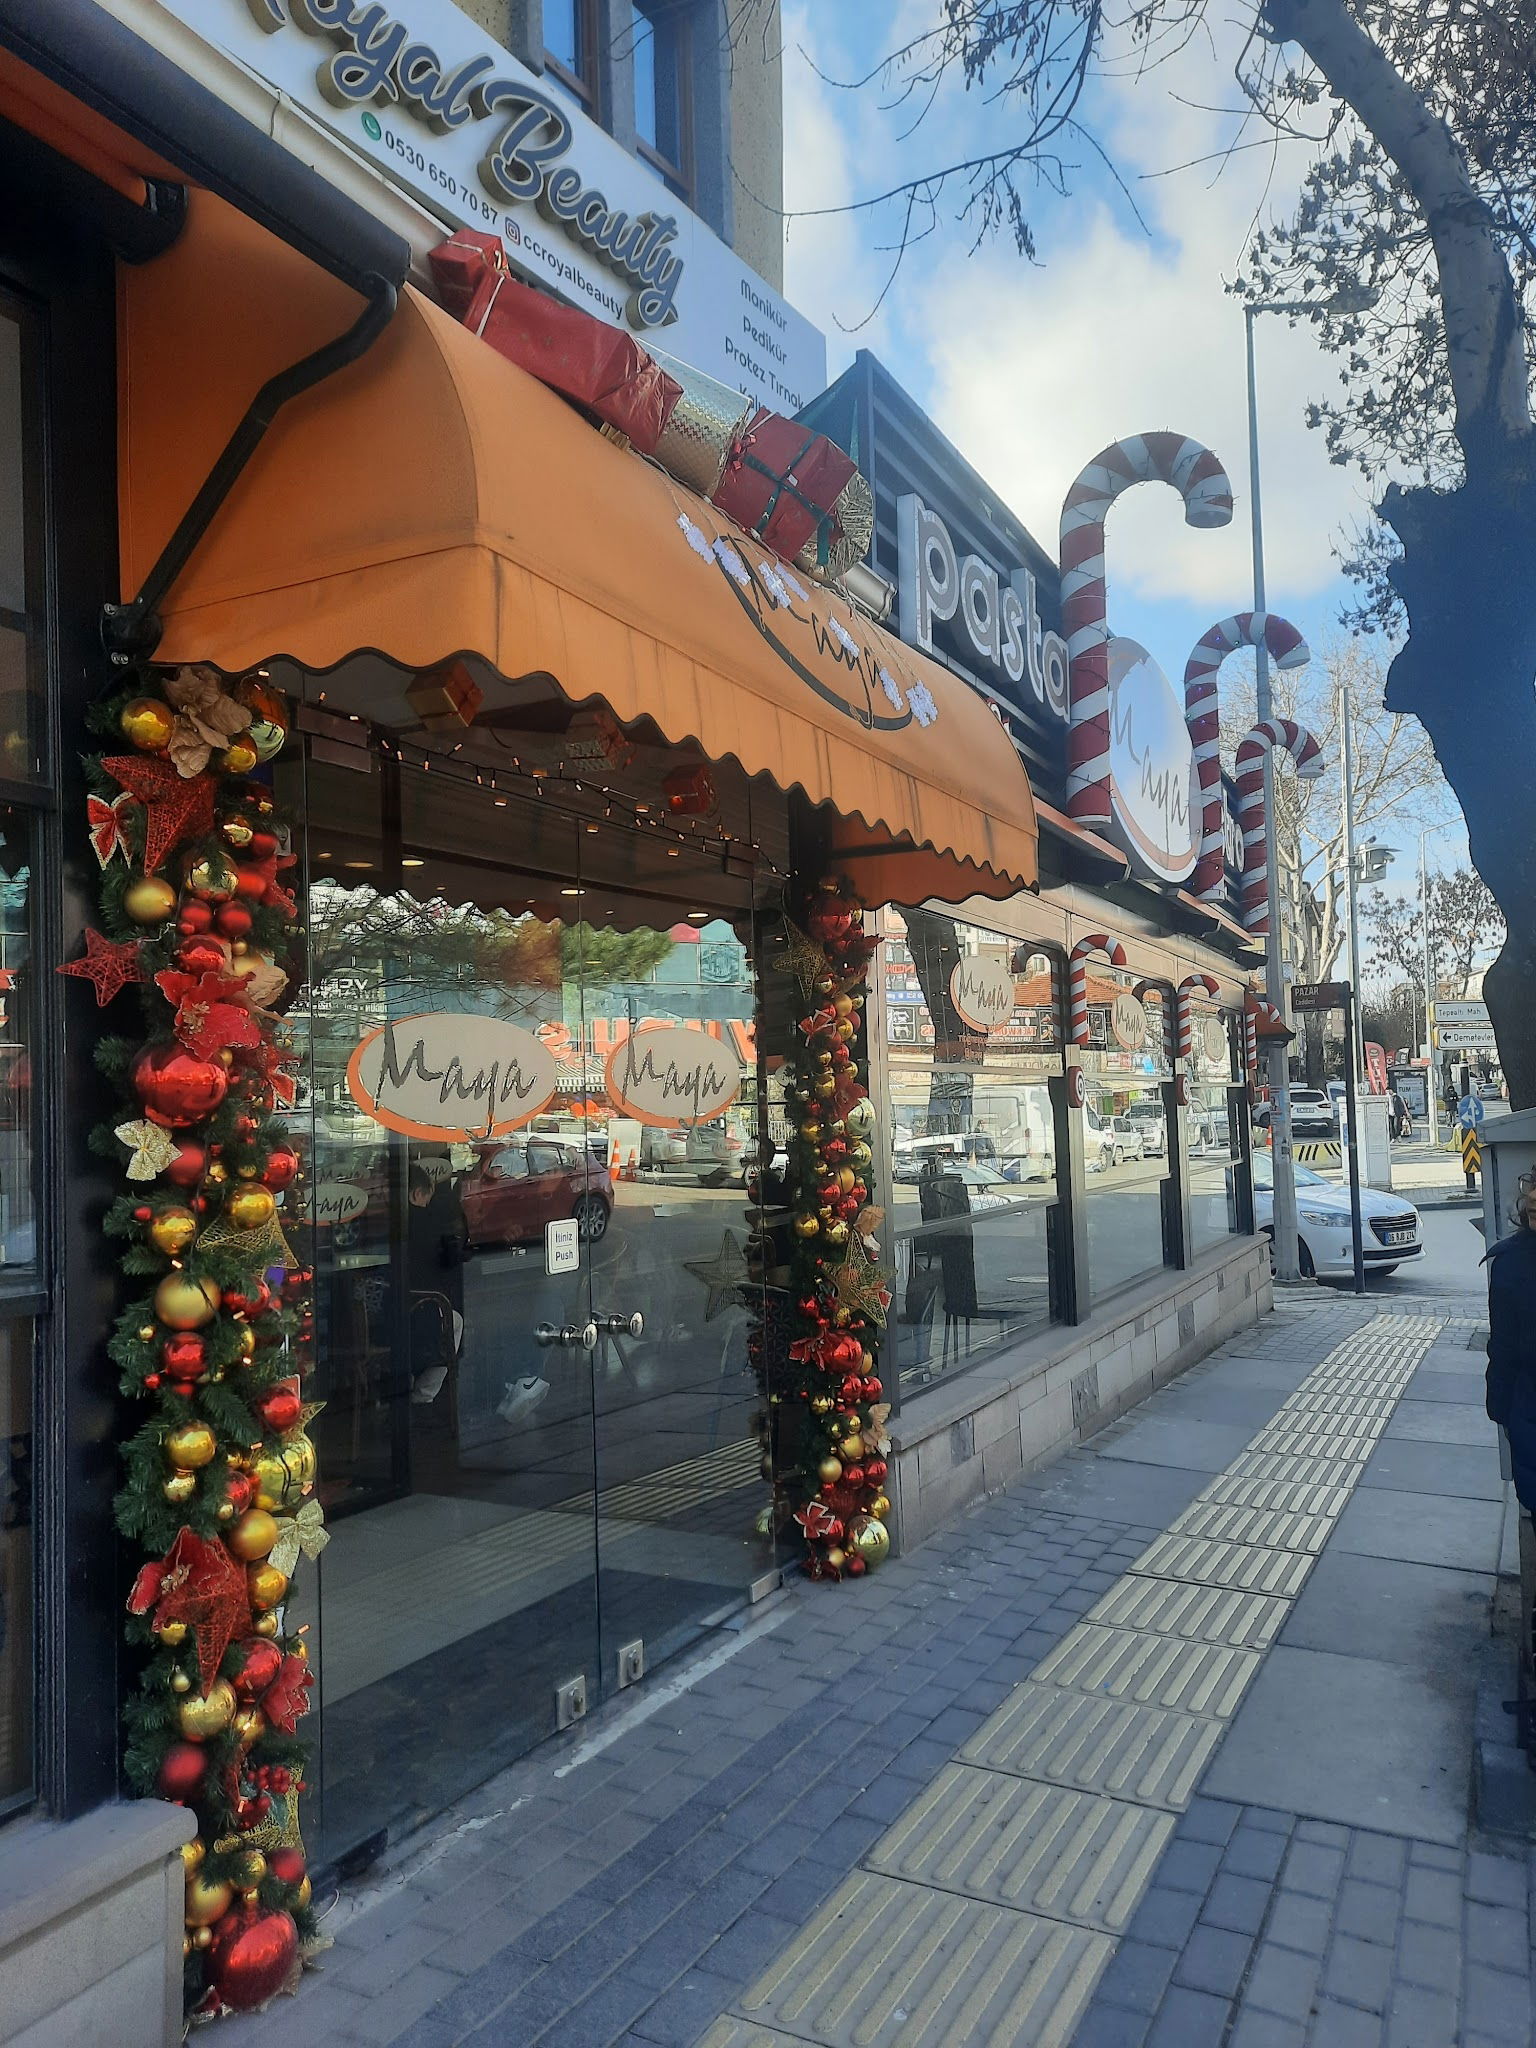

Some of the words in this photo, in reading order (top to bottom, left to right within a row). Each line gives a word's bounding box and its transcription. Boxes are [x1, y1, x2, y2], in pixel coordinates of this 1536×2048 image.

[384, 129, 425, 173] 0530
[428, 165, 458, 196] 650
[459, 184, 479, 211] 70
[480, 201, 499, 226] 87
[476, 78, 686, 327] Beauty
[522, 233, 623, 320] ccroyalbeauty
[740, 278, 788, 333] Manikür
[725, 335, 767, 385] Protez
[743, 314, 788, 366] Pedikür
[904, 493, 1071, 724] pasta
[957, 958, 1009, 1026] Maya
[1294, 986, 1319, 997] PAZAR
[374, 1020, 538, 1143] Maya
[621, 1030, 726, 1128] Maya
[555, 1250, 574, 1261] Push
